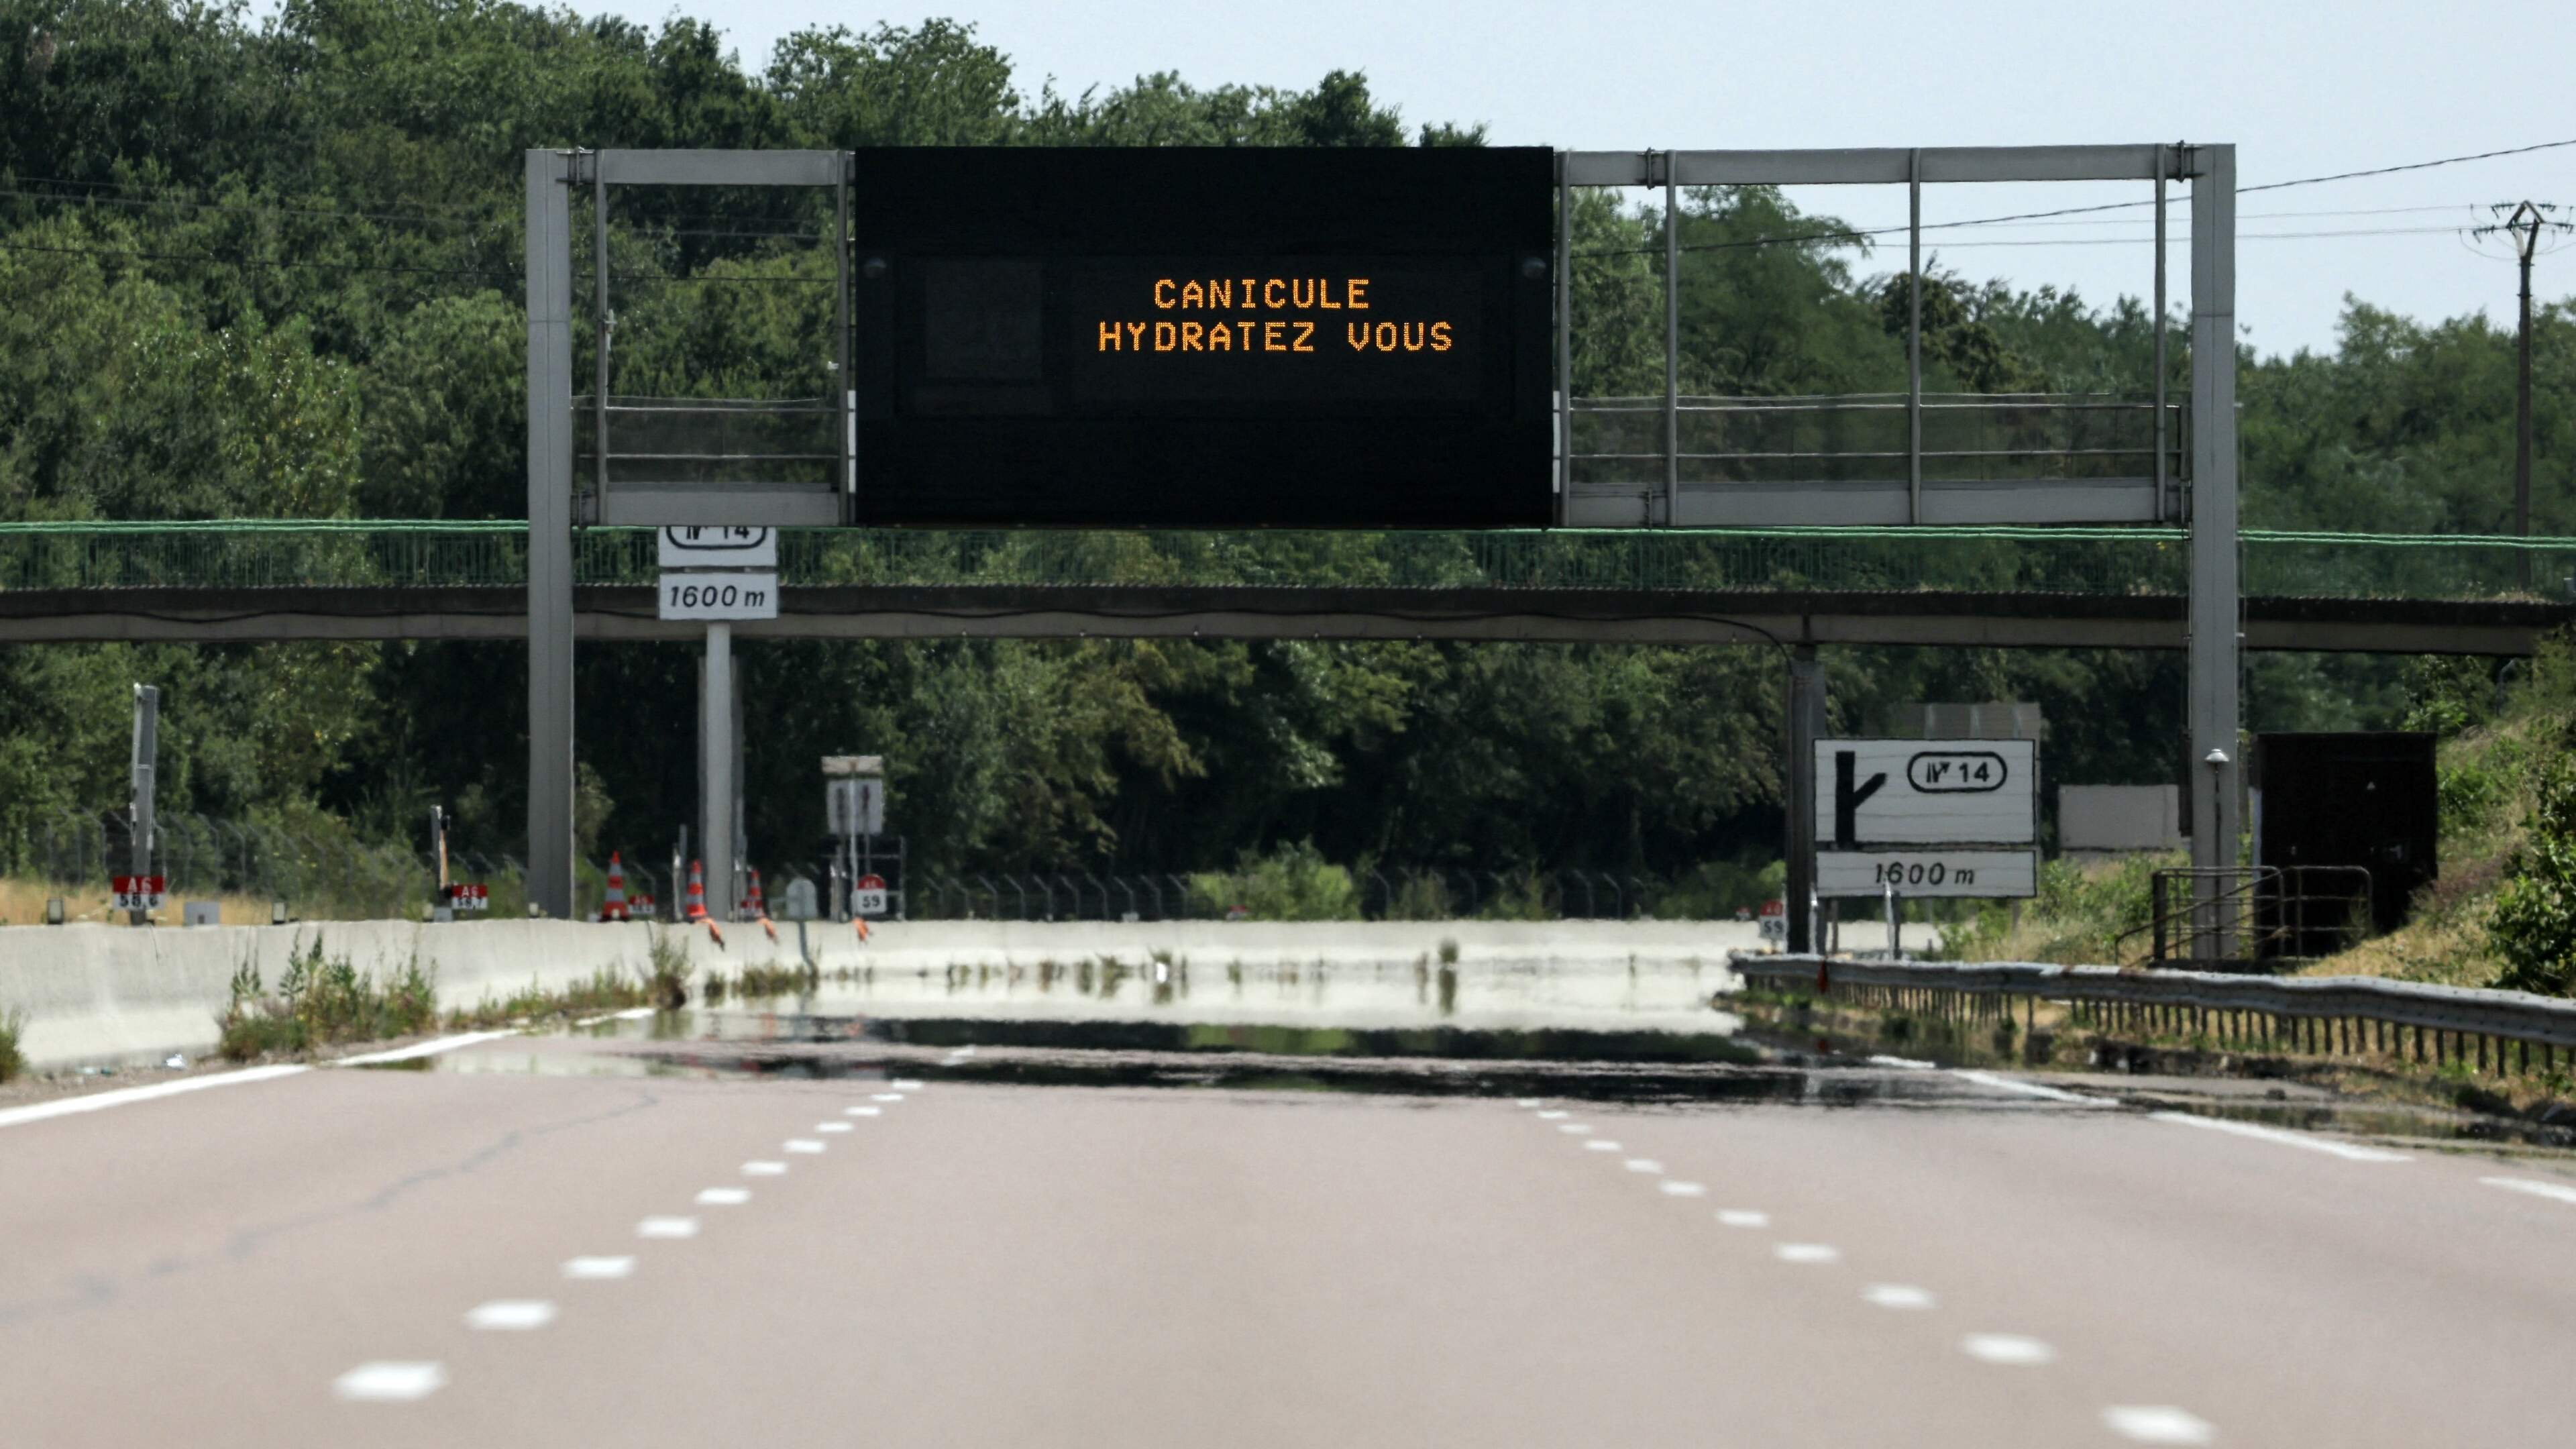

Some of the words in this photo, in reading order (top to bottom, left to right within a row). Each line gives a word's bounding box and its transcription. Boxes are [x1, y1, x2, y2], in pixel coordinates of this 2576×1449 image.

[1154, 278, 1369, 309] CANICULE
[1098, 321, 1315, 352] HYDRATEZ
[1347, 321, 1453, 352] VOUS
[671, 584, 737, 608] 1600
[744, 590, 765, 607] m
[1958, 761, 1990, 783] 14
[1875, 861, 1945, 885] 1600
[1954, 868, 1975, 885] m
[127, 877, 152, 894] A6
[862, 895, 880, 908] 59
